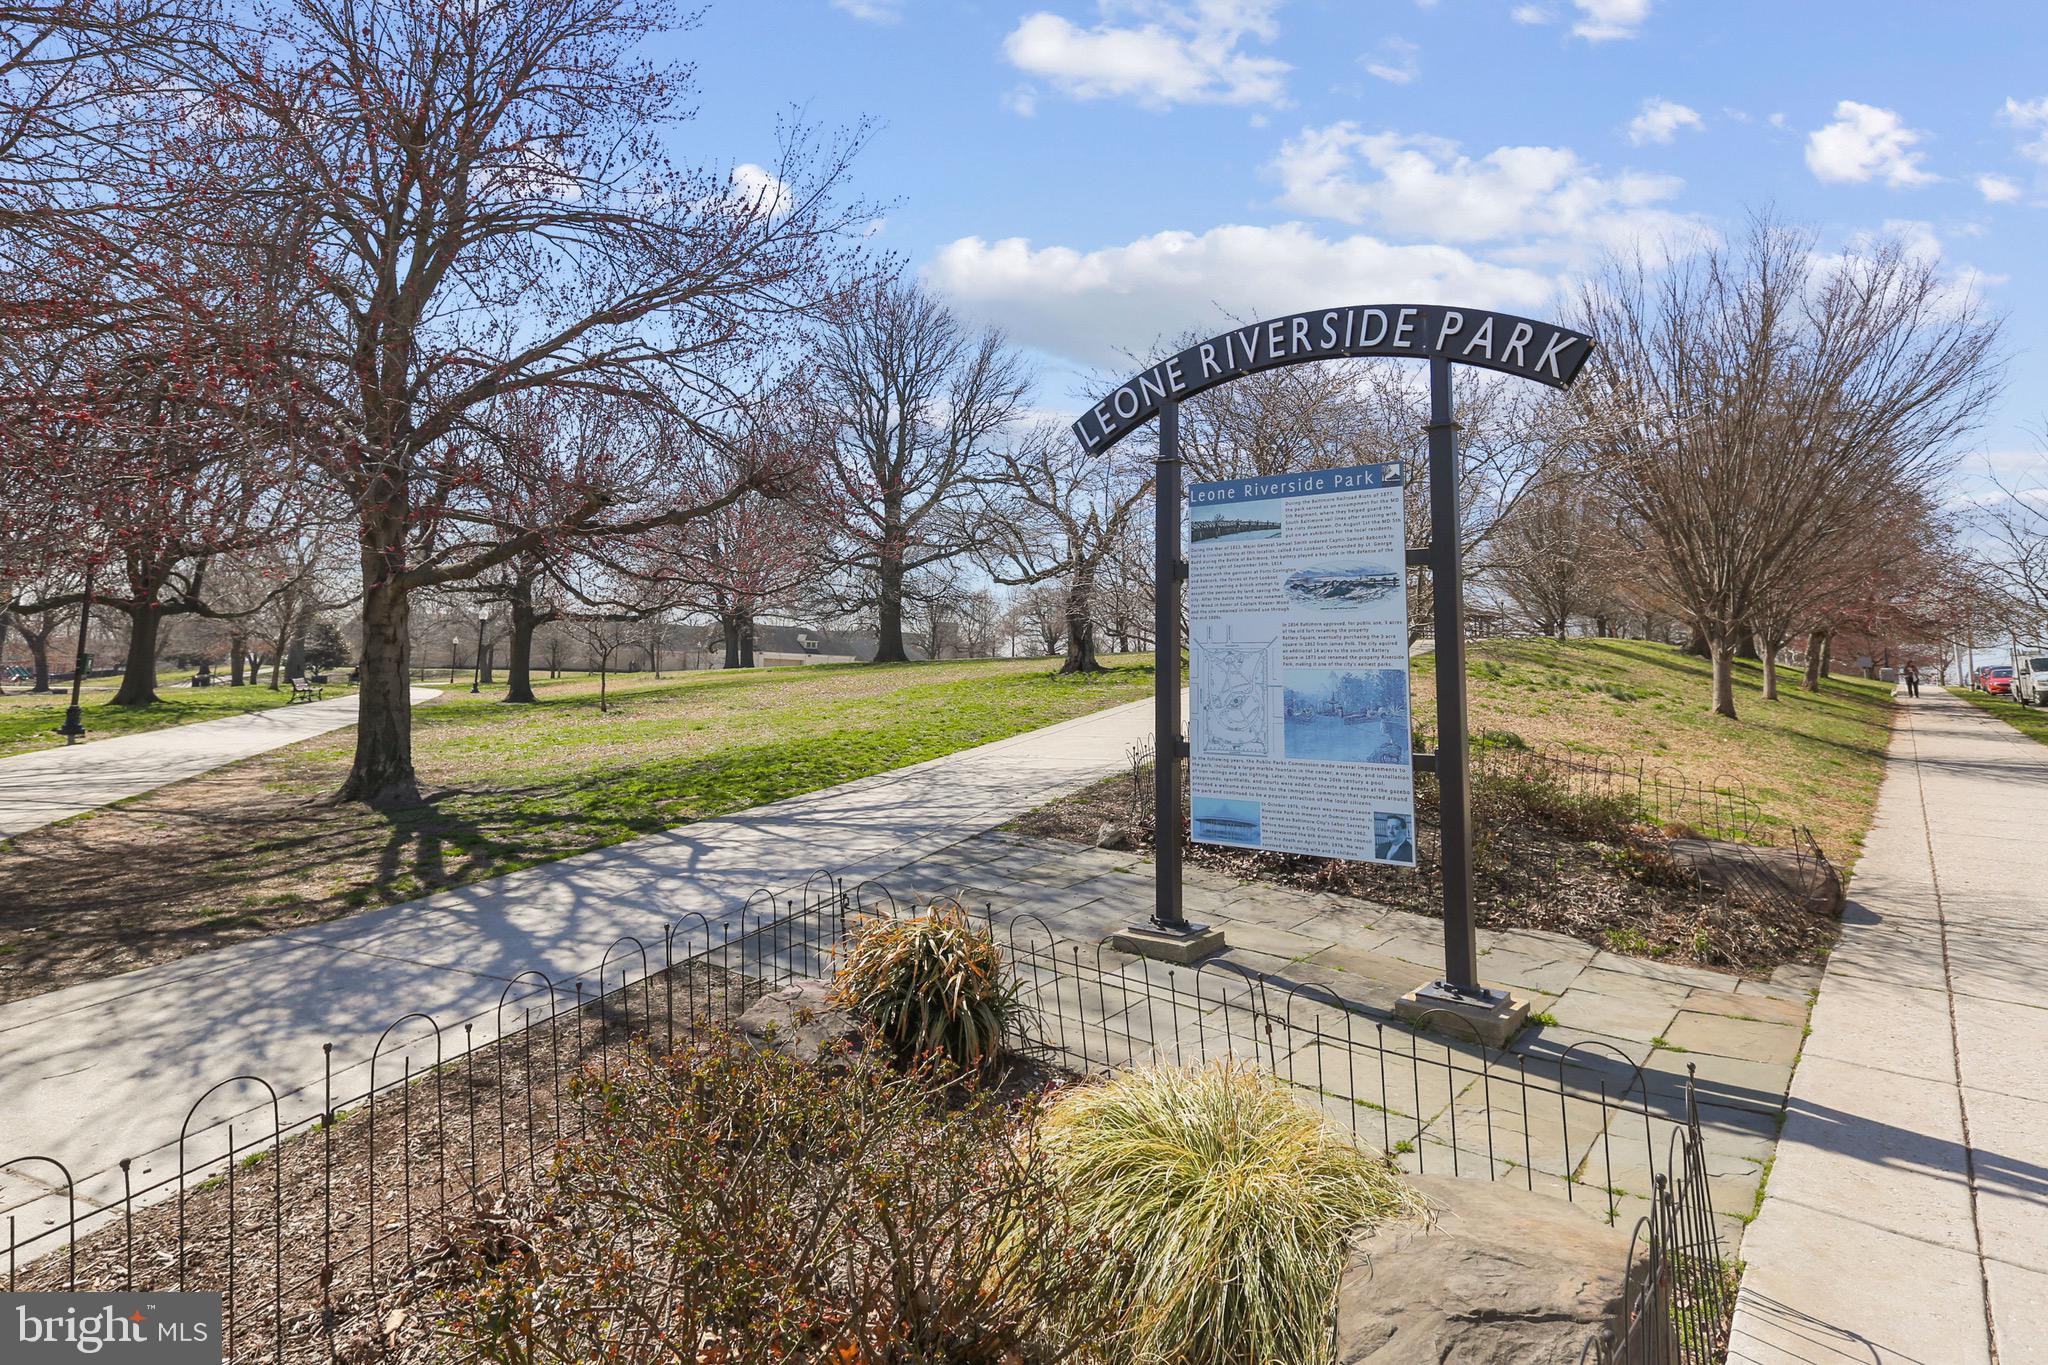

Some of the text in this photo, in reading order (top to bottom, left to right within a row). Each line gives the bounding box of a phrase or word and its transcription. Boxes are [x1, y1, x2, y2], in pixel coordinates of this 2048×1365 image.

[1076, 308, 1577, 447] LEONE RIVERSIDE PARK
[1191, 470, 1374, 503] Leone Riverside Park
